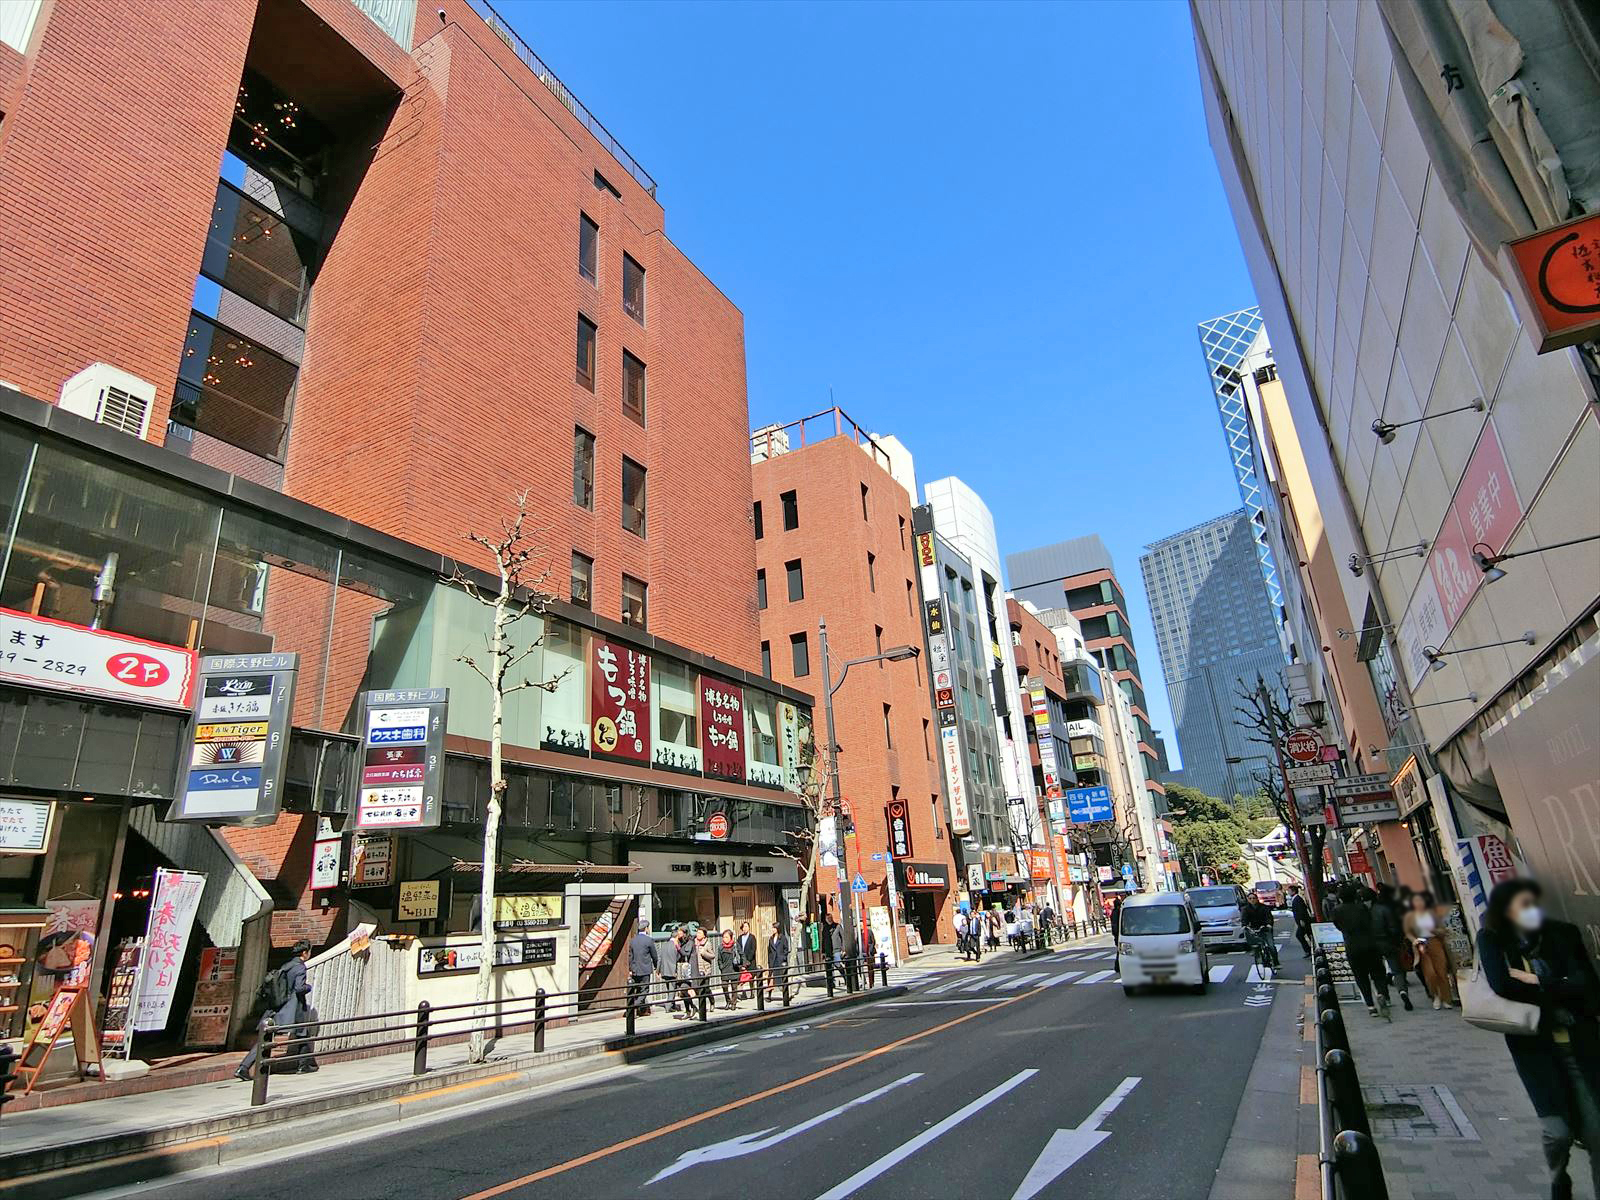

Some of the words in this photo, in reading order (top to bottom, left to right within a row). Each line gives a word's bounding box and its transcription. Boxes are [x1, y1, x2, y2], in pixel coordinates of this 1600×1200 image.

[10, 630, 50, 649] ます
[117, 656, 161, 682] 2F
[211, 656, 288, 669] 国際天野ビル
[637, 653, 647, 702] 博多名物
[374, 690, 440, 702] 国際天野ビル
[597, 645, 637, 739] もつ鍋
[705, 687, 740, 711] 博多名物
[230, 724, 264, 736] Tiger
[371, 728, 425, 741] ウスキ歯科
[708, 725, 739, 752] もつ鍋
[1289, 740, 1317, 753] 消火栓
[694, 860, 753, 878] 築地すし好
[415, 907, 436, 917] B1F
